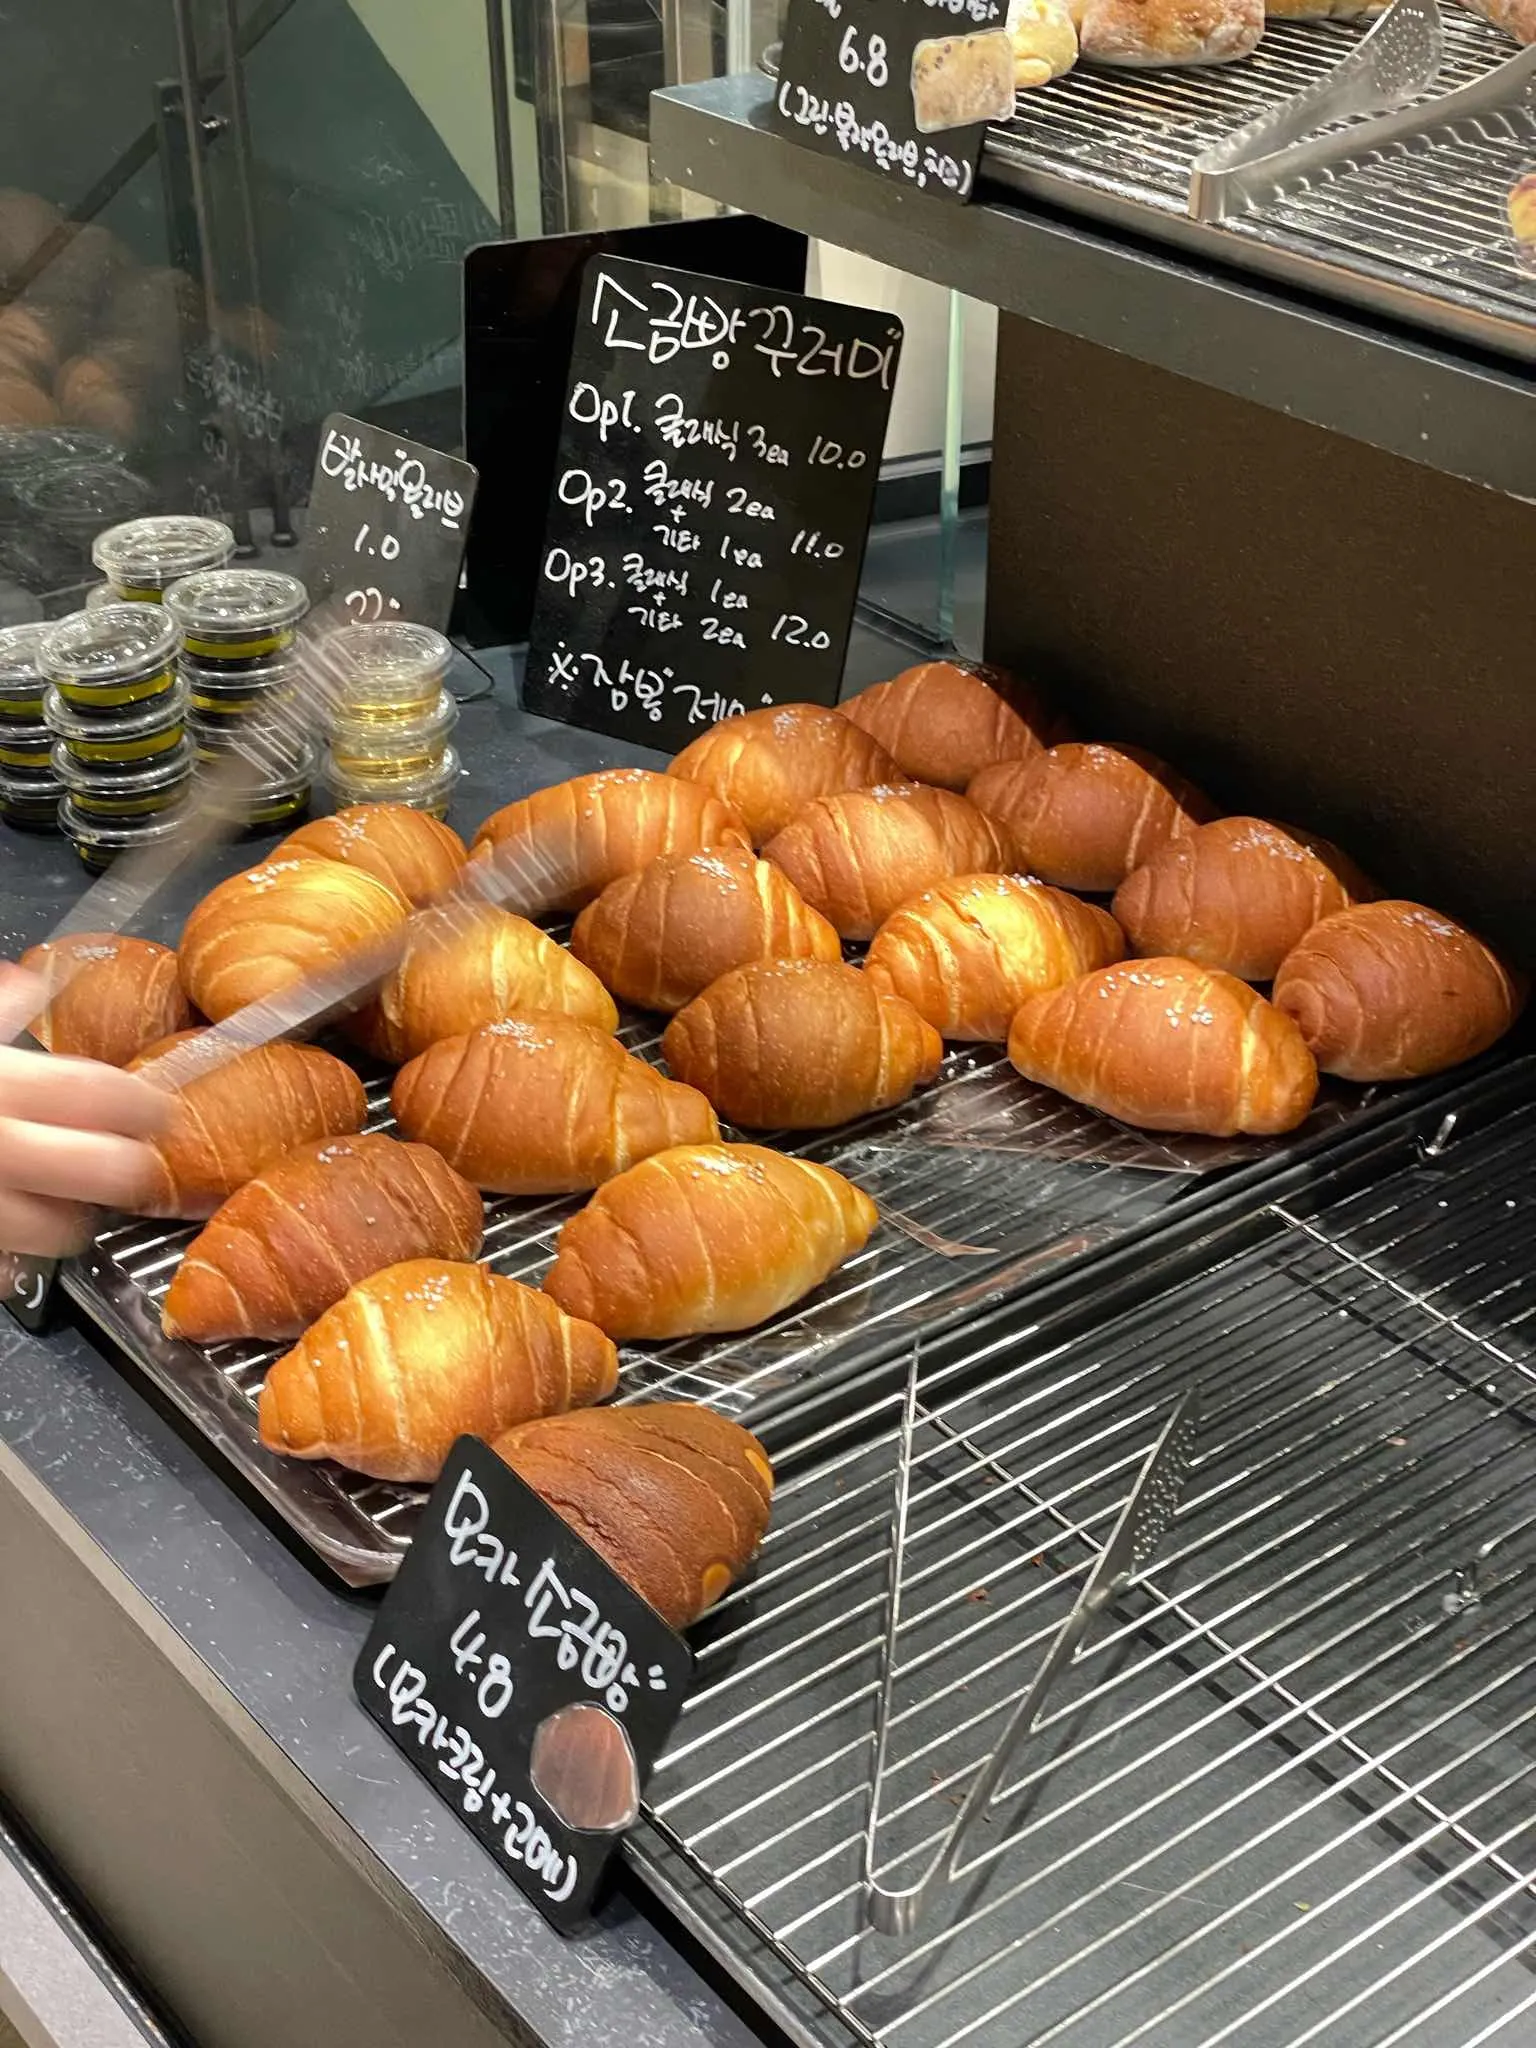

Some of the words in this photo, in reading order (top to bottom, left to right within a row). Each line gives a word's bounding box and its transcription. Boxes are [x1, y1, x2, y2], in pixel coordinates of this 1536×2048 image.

[839, 25, 889, 88] 6.8
[591, 272, 748, 371] 소금빵
[654, 392, 740, 463] 클래식
[746, 424, 789, 467] 3ea
[808, 435, 868, 470] 10.0
[643, 459, 715, 509] 클래식
[725, 487, 776, 521] 2ea
[354, 523, 400, 561] 1.0
[653, 525, 701, 553] 기타
[790, 529, 845, 559] 11.0
[622, 552, 689, 597] 클래식
[628, 606, 684, 633] 기타
[700, 616, 747, 649] 2ea
[770, 613, 831, 650] 12.0
[445, 1468, 521, 1586] 모카
[450, 1609, 514, 1719] 4.8
